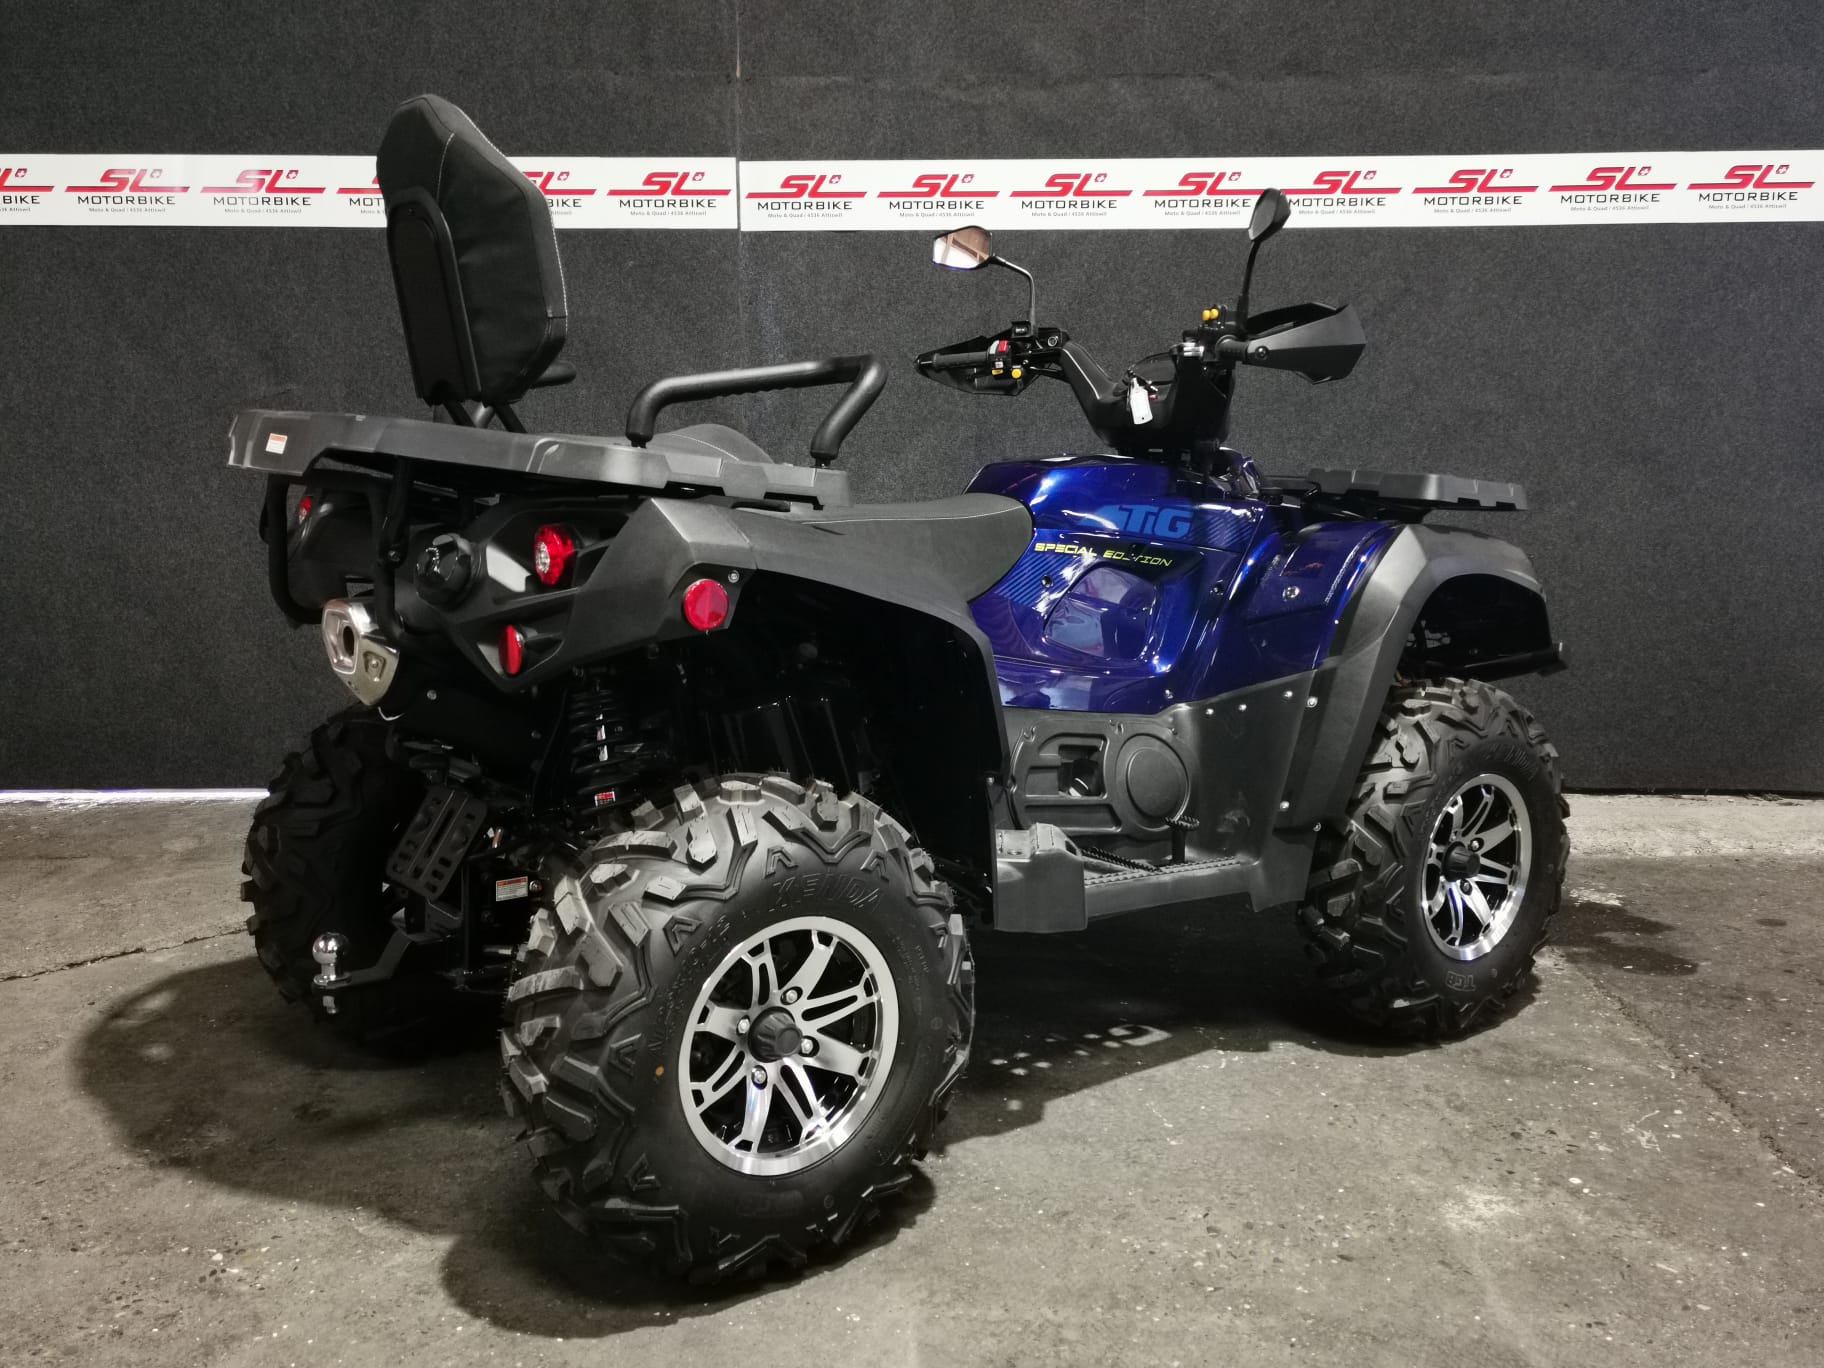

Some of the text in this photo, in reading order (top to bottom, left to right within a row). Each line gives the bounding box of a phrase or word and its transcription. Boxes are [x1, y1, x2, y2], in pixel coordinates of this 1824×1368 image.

[65, 169, 190, 193] SL
[201, 169, 326, 194] SL
[607, 171, 731, 196] SL
[1142, 171, 1264, 196] SL
[1281, 170, 1402, 196] SL
[1412, 169, 1538, 194] SL
[1548, 166, 1677, 192] SL
[1687, 164, 1814, 190] SL
[745, 174, 867, 199] SL
[877, 174, 1000, 199] SL
[1009, 173, 1133, 197] SL
[77, 195, 176, 205] MOTORBIKE
[213, 196, 312, 206] MOTORBIKE
[619, 198, 717, 208] MOTORBIKE
[1021, 199, 1118, 209] MOTORBIKE
[1154, 198, 1252, 208] MOTORBIKE
[1288, 196, 1386, 207] MOTORBIKE
[1423, 195, 1523, 206] MOTORBIKE
[1560, 193, 1661, 204] MOTORBIKE
[1698, 191, 1799, 202] MOTORBIKE
[757, 200, 853, 210] MOTORBIKE
[888, 200, 985, 210] MOTORBIKE
[1034, 542, 1097, 557] SPECIAL
